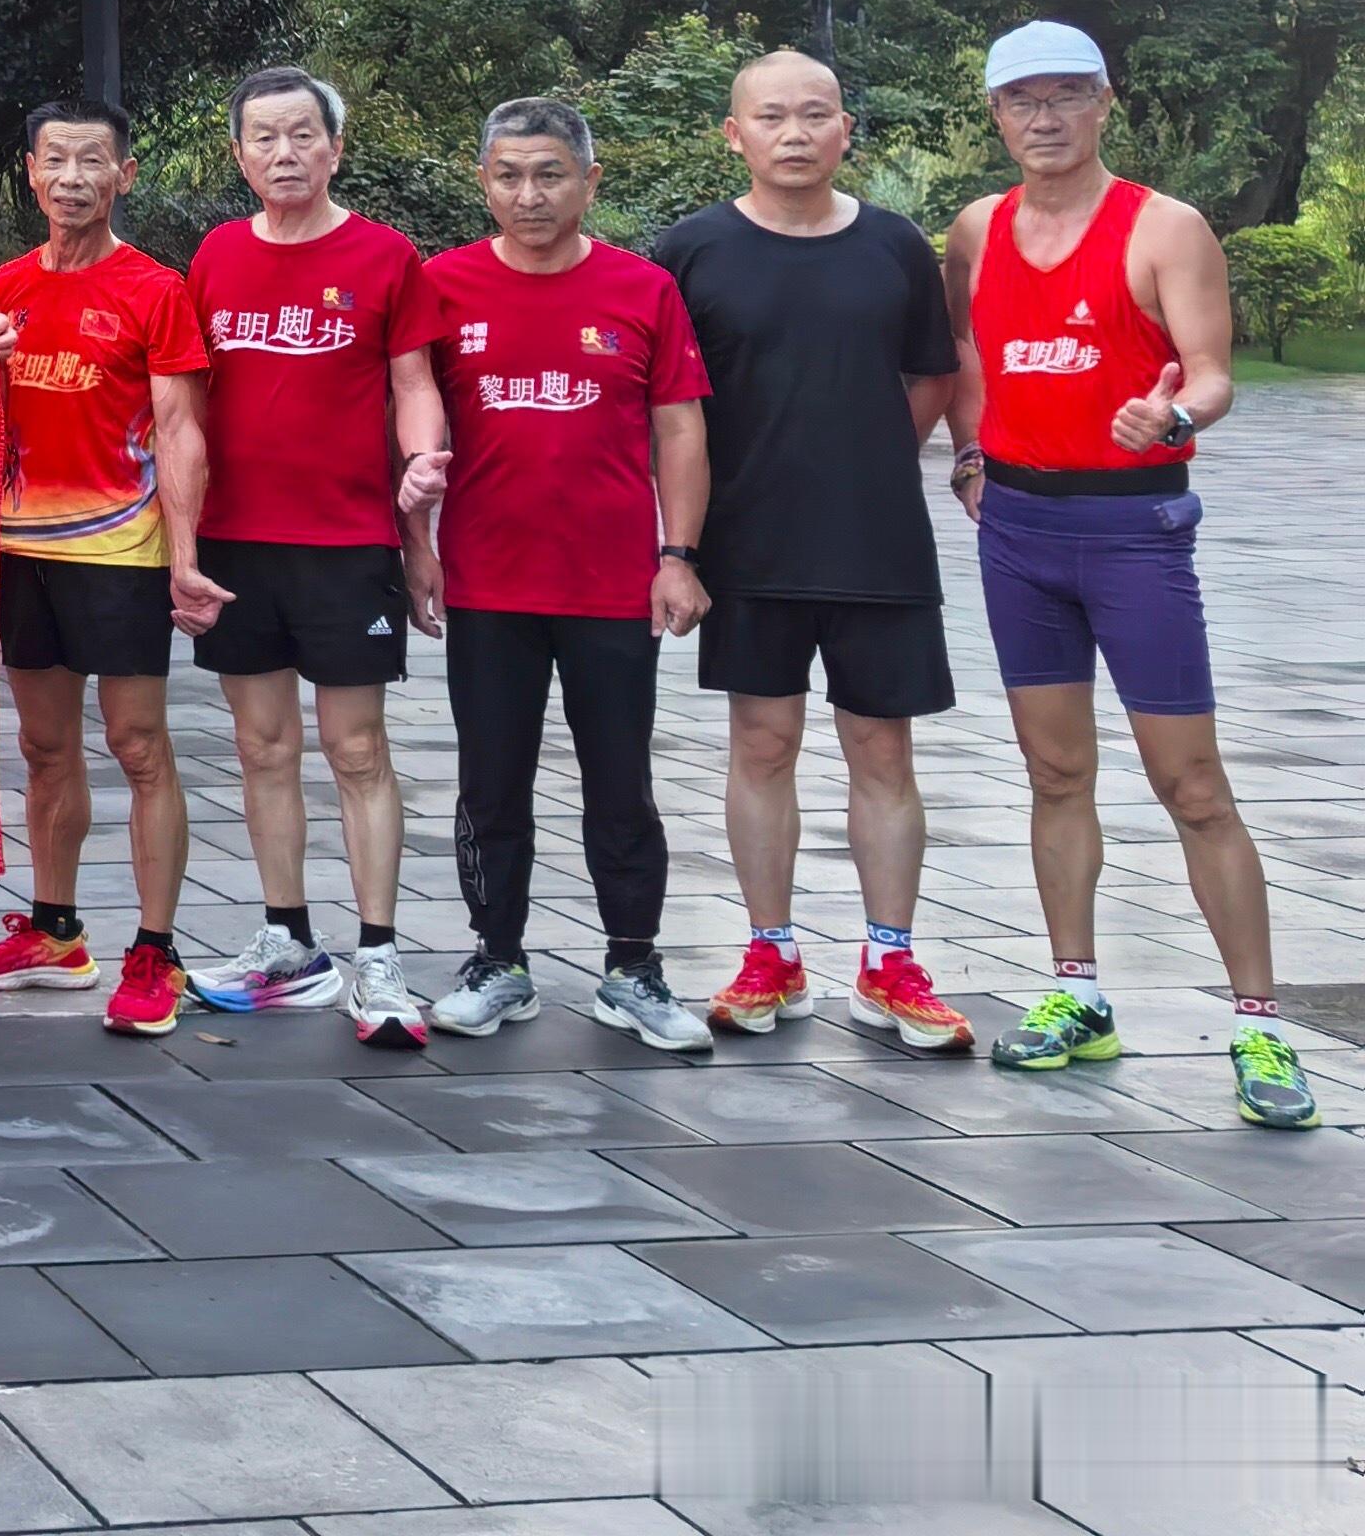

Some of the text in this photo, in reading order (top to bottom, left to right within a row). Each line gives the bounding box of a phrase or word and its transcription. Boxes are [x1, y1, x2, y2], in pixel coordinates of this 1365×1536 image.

[210, 305, 356, 348] 黎明脚步
[460, 322, 488, 337] 中国
[459, 338, 487, 354] 龙岩
[1002, 336, 1101, 369] 黎明脚步
[7, 351, 103, 386] 黎明脚步
[478, 370, 602, 404] 黎明脚步
